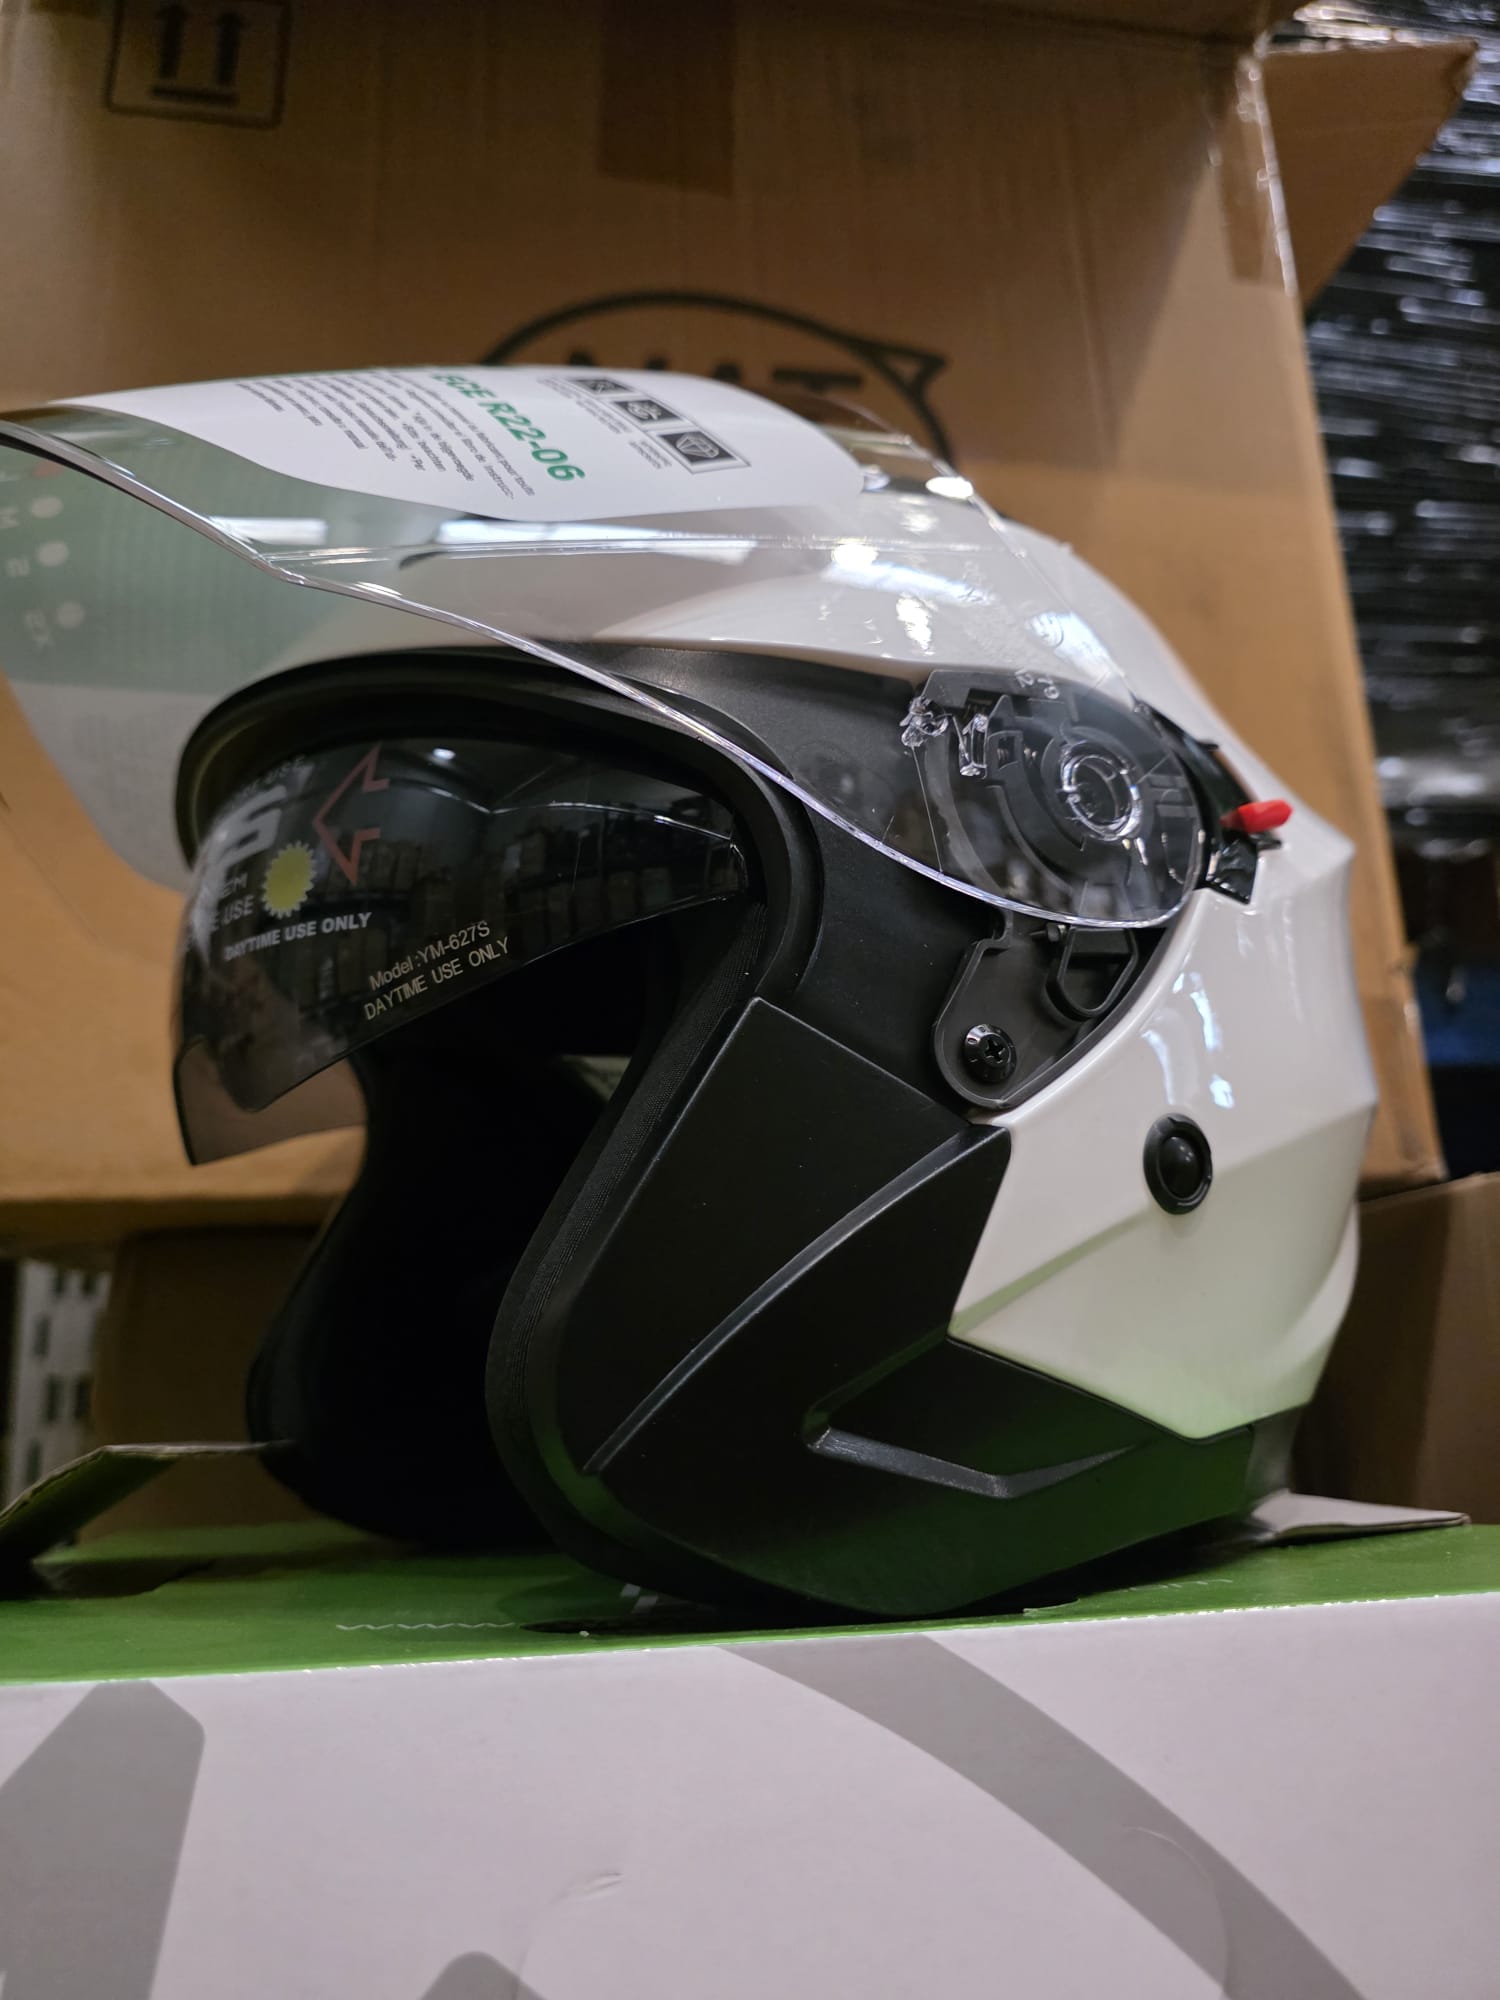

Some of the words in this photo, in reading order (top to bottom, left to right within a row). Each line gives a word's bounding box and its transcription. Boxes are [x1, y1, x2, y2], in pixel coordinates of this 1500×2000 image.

[432, 376, 497, 398] ECE
[478, 402, 586, 481] R22-06
[223, 928, 281, 962] DAYTIME
[285, 917, 317, 942] USE
[321, 911, 372, 935] ONLY
[364, 974, 428, 1021] DAYTIME
[432, 957, 463, 984] USE
[468, 936, 510, 968] ONLY
